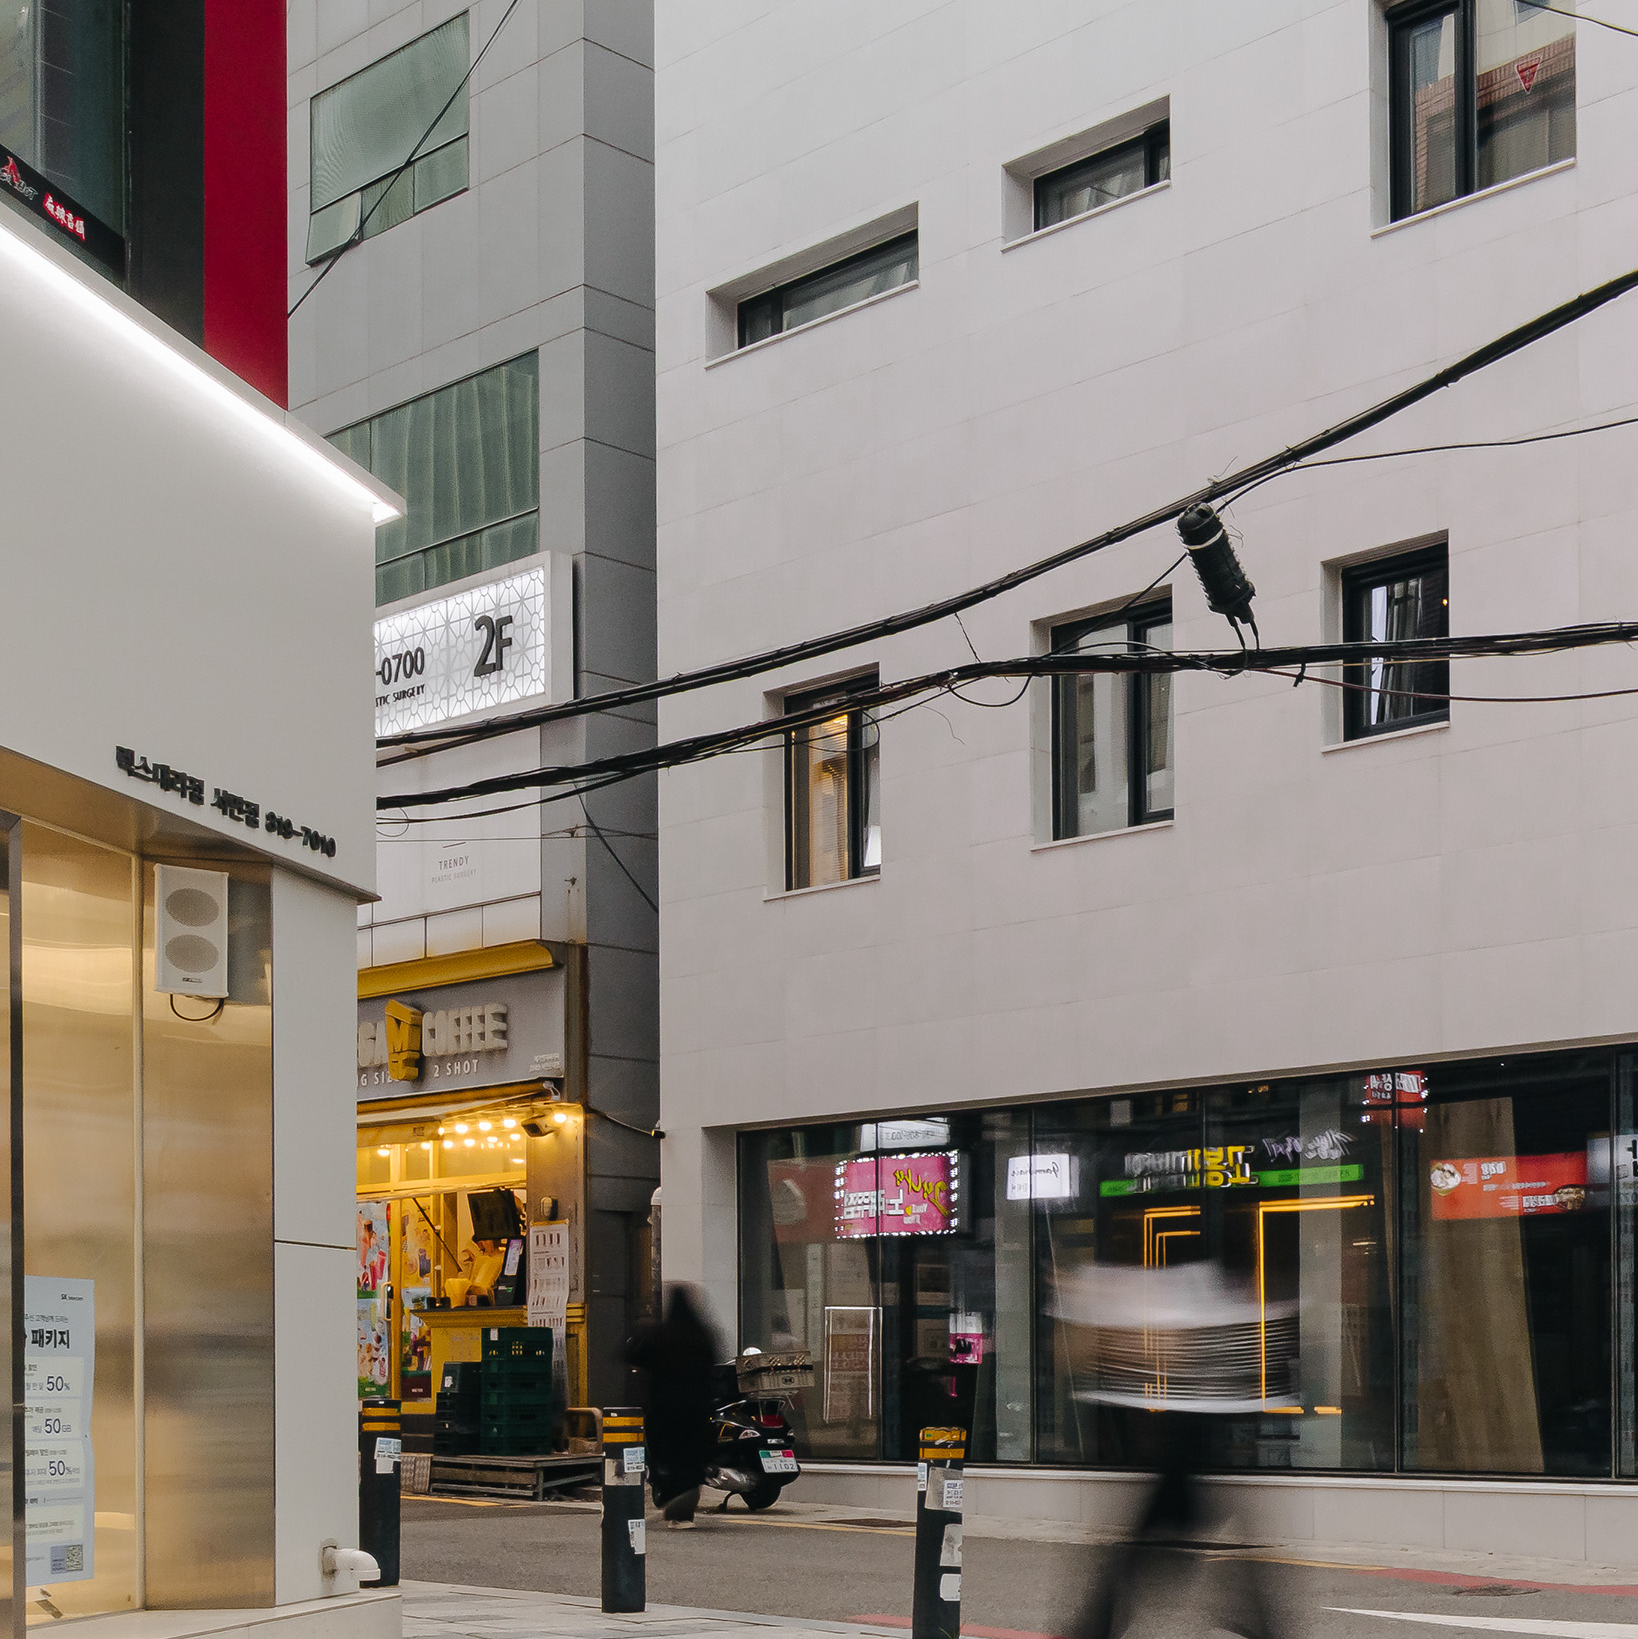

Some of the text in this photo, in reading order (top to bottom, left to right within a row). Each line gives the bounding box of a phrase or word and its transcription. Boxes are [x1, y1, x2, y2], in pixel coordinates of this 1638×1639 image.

[473, 614, 513, 678] 2F
[438, 855, 470, 871] TRENDY
[422, 1003, 508, 1057] COFFEE
[434, 1064, 440, 1078] 2
[446, 1059, 479, 1076] SHOT
[31, 1327, 71, 1349] 패키지
